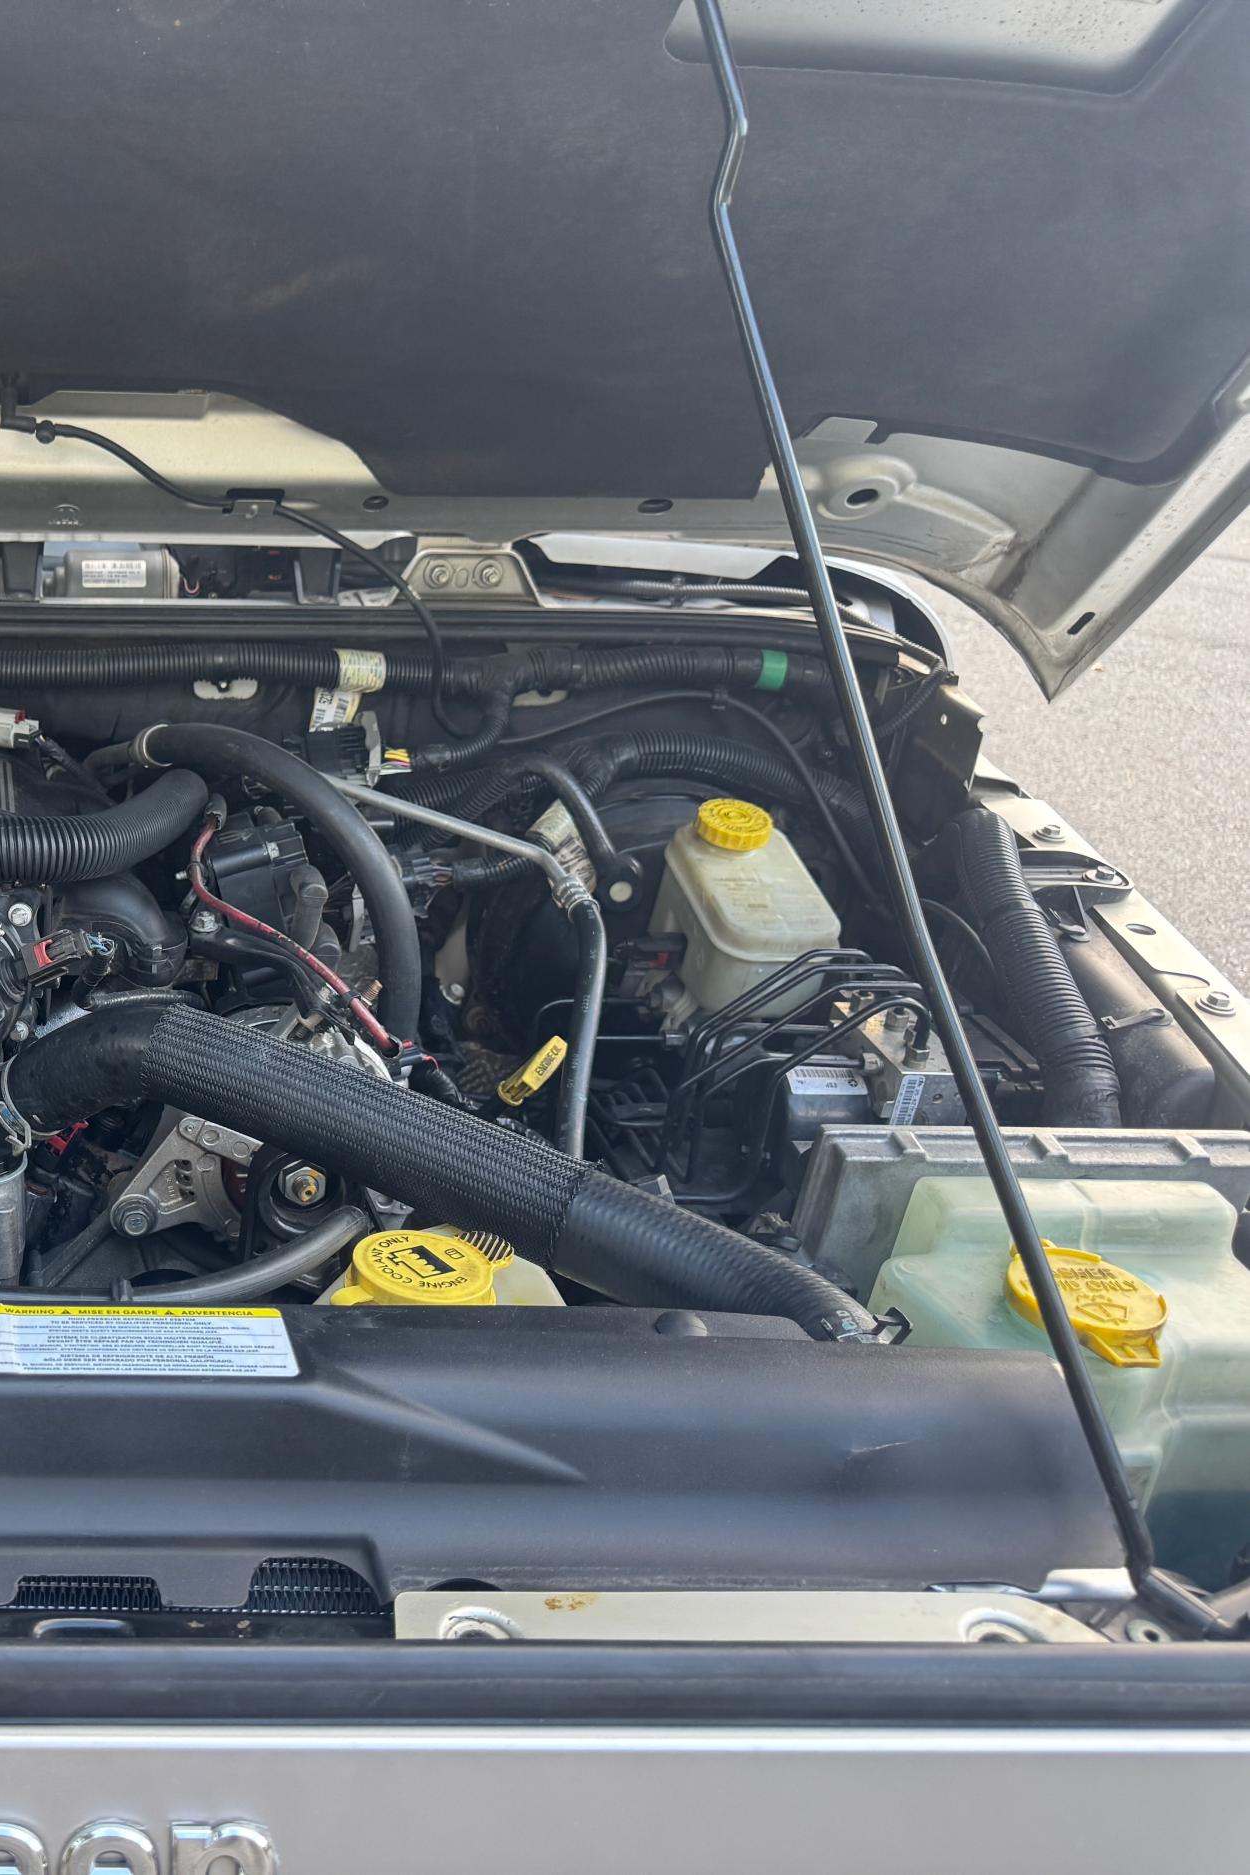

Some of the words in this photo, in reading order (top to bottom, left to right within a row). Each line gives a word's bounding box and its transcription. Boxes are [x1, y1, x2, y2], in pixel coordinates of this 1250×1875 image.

[534, 1051, 556, 1077] ENGINE
[378, 1235, 410, 1248] ONLY
[371, 1247, 413, 1284] COOLANT
[418, 1276, 468, 1288] ENGINE
